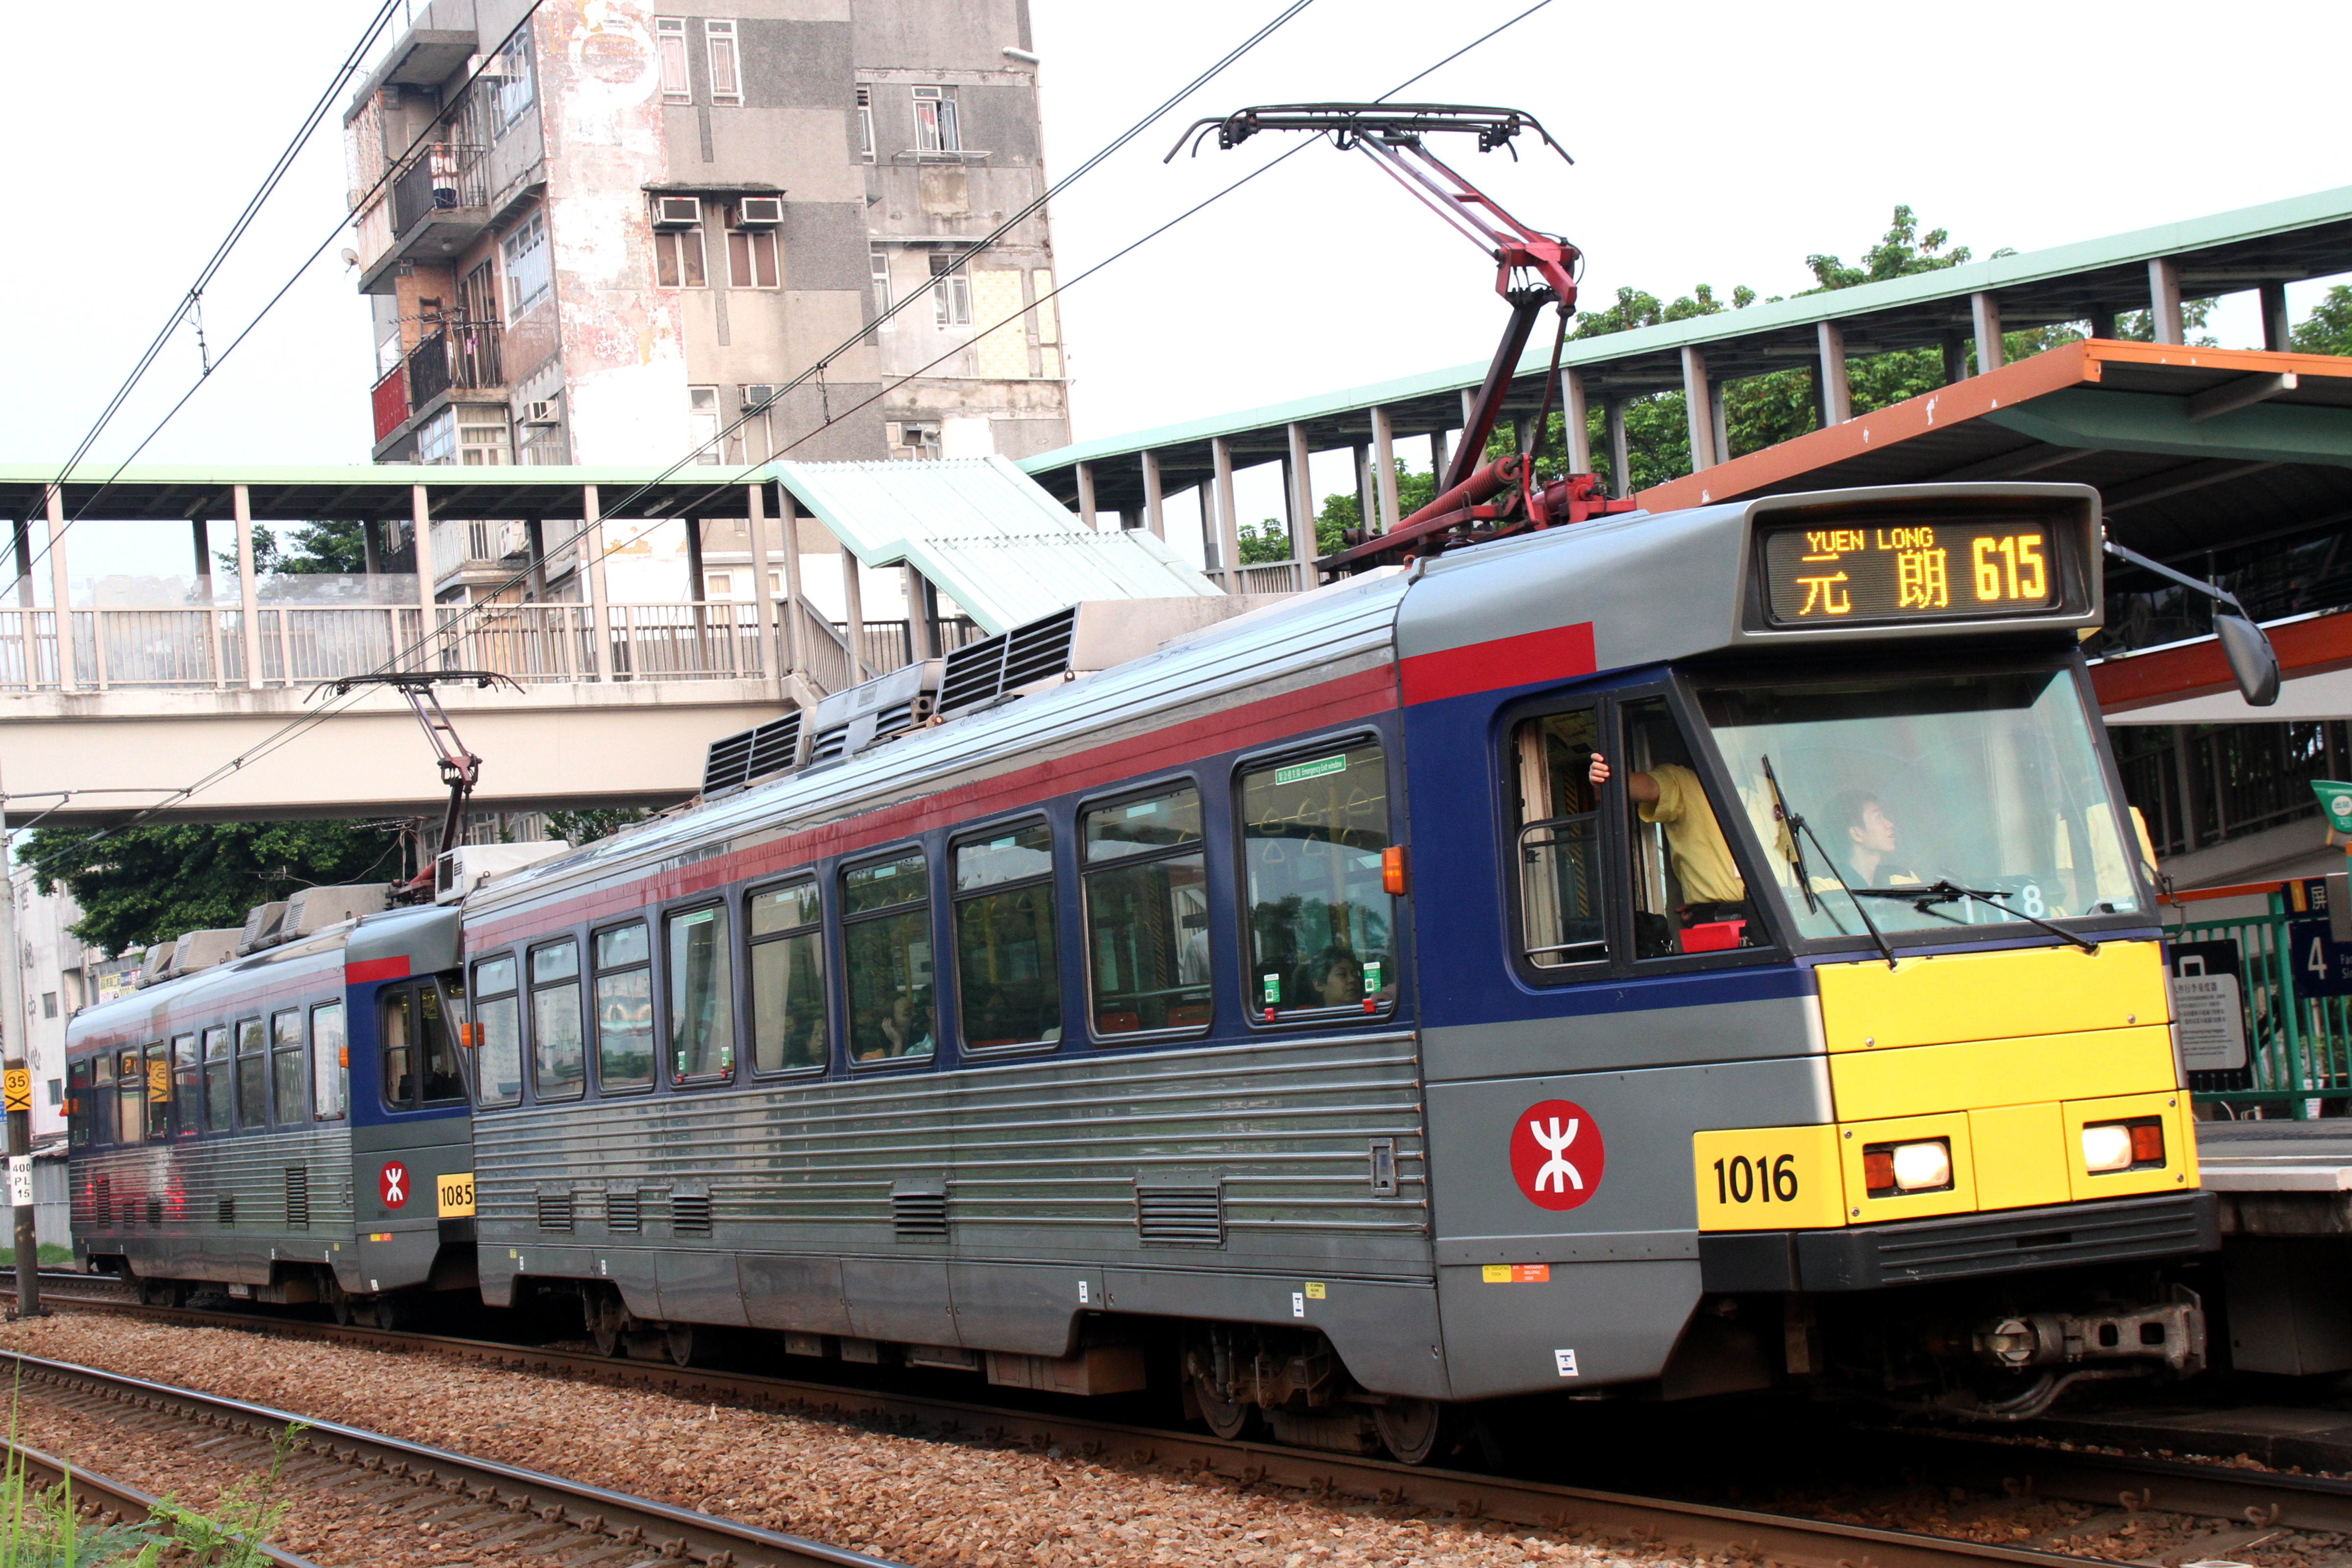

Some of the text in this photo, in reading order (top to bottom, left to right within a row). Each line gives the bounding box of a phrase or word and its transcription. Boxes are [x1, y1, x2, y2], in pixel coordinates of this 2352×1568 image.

[1807, 527, 1933, 552] YUEN LONG
[1973, 535, 2046, 600] 615
[1797, 548, 1948, 615] 元朗
[1301, 766, 1321, 776] Emergency
[1958, 884, 2044, 924] 118
[2308, 936, 2328, 980] 4
[8, 1076, 25, 1088] 35
[13, 1163, 31, 1173] 400
[1714, 1154, 1798, 1204] 1016
[18, 1189, 30, 1198] 15
[441, 1184, 473, 1206] 1085
